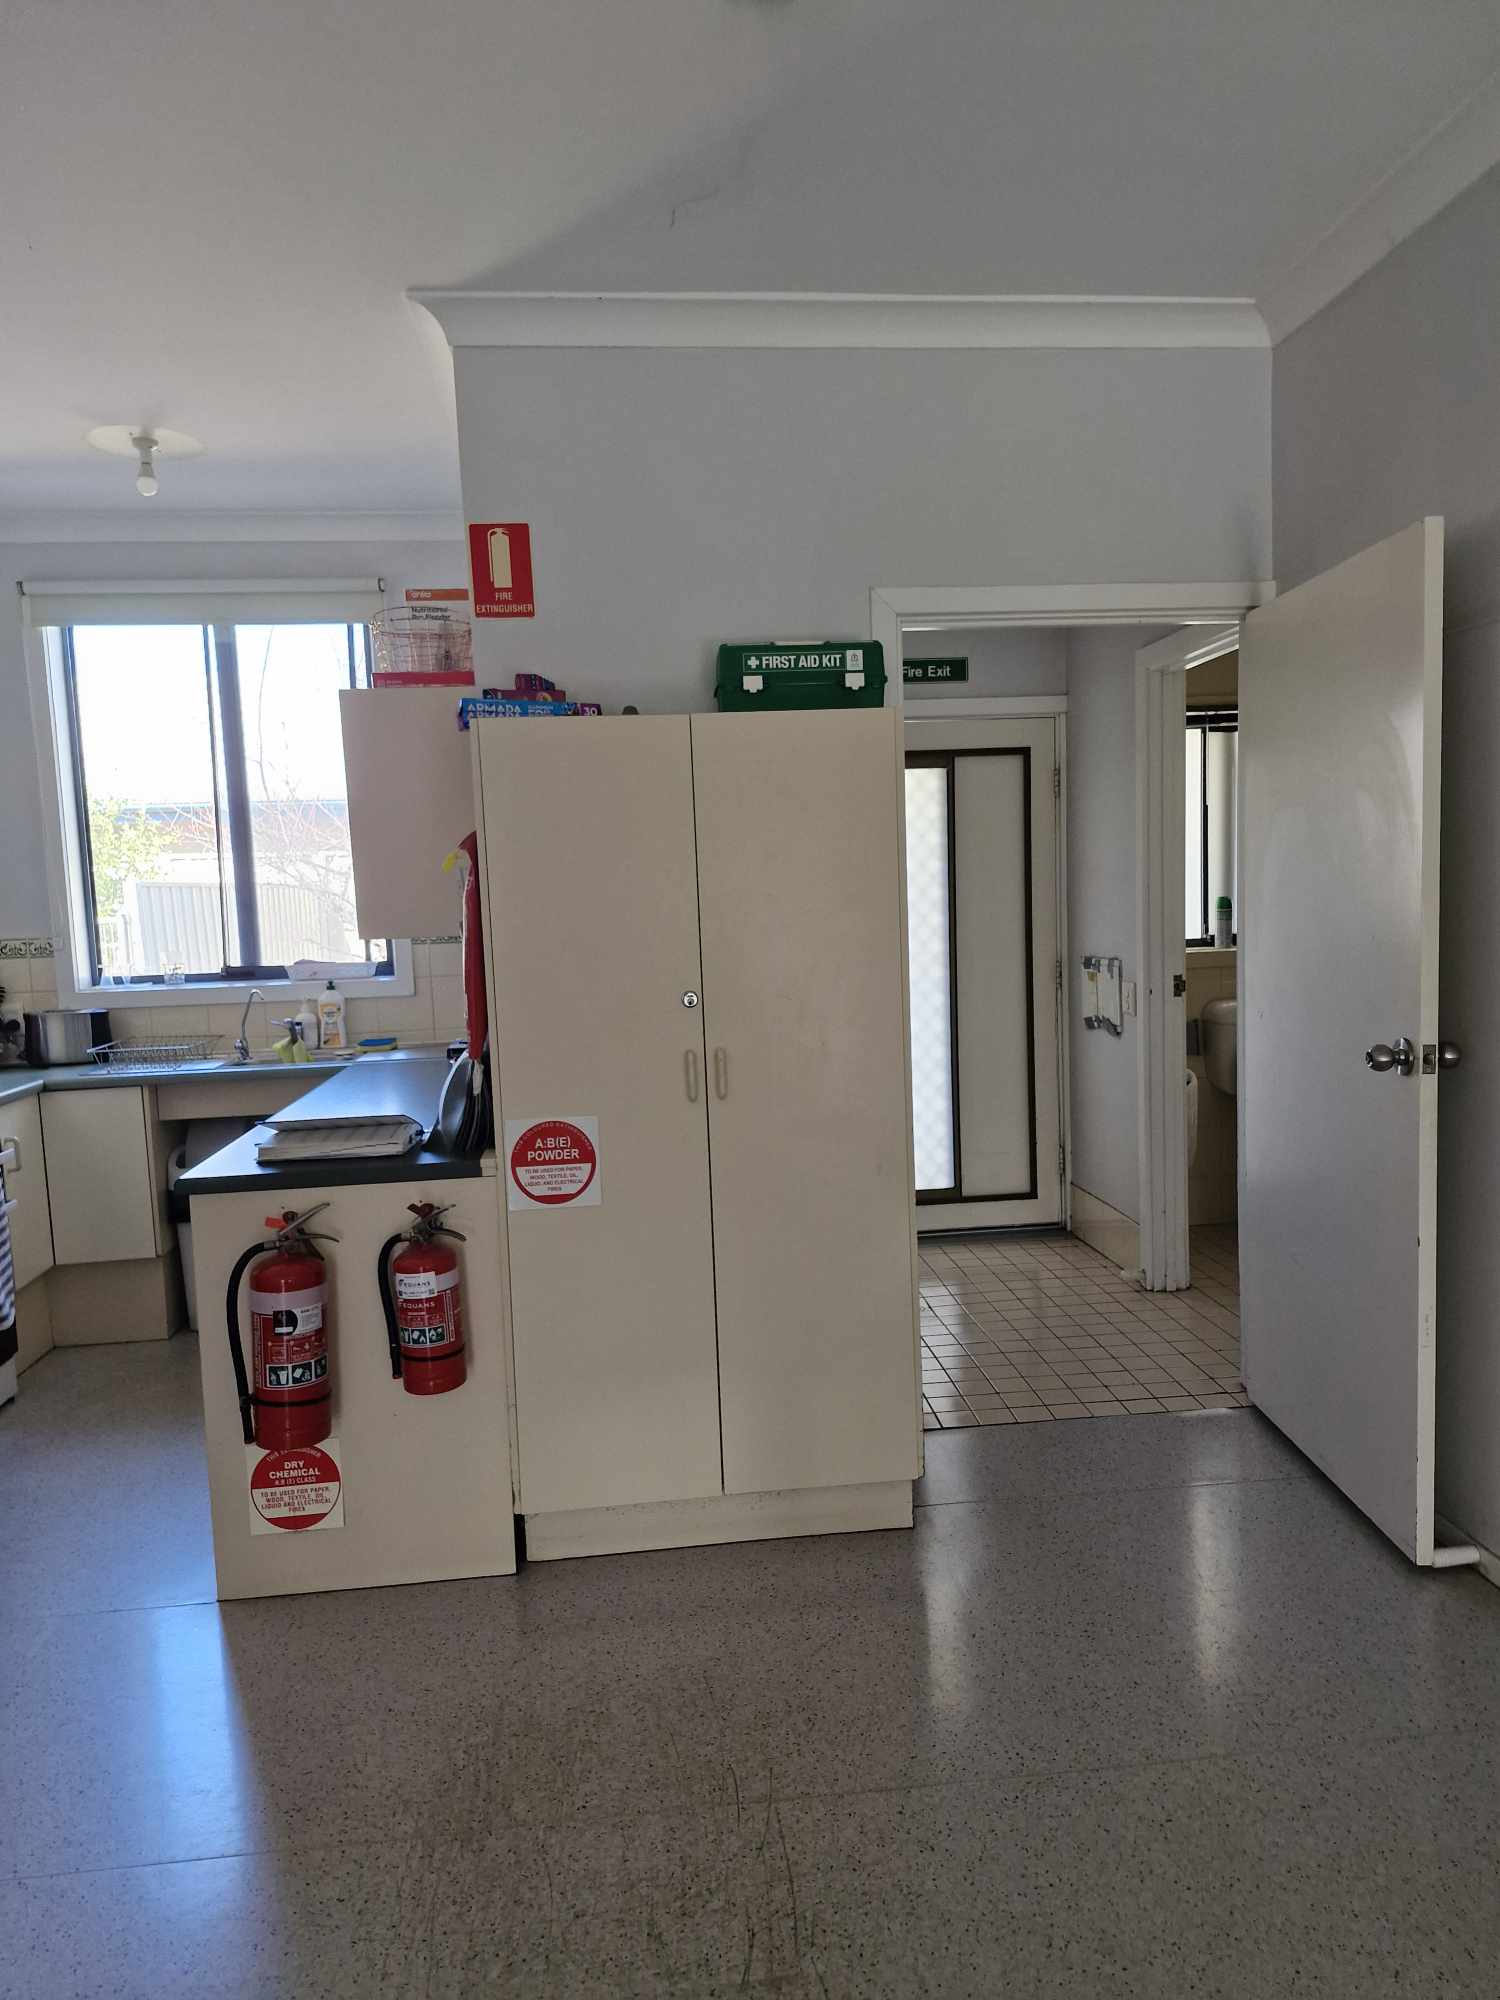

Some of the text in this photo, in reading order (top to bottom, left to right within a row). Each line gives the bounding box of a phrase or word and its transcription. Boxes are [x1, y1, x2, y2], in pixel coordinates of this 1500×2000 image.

[495, 591, 513, 601] FIRE
[476, 604, 533, 613] EXTINGUISHER
[762, 656, 797, 669] FIRST
[798, 655, 820, 668] AID
[822, 654, 842, 667] KIT
[902, 665, 952, 677] Fire Exit
[527, 1149, 580, 1162] POWDER
[284, 1460, 305, 1470] DRY
[268, 1467, 321, 1480] CHEMICAL
